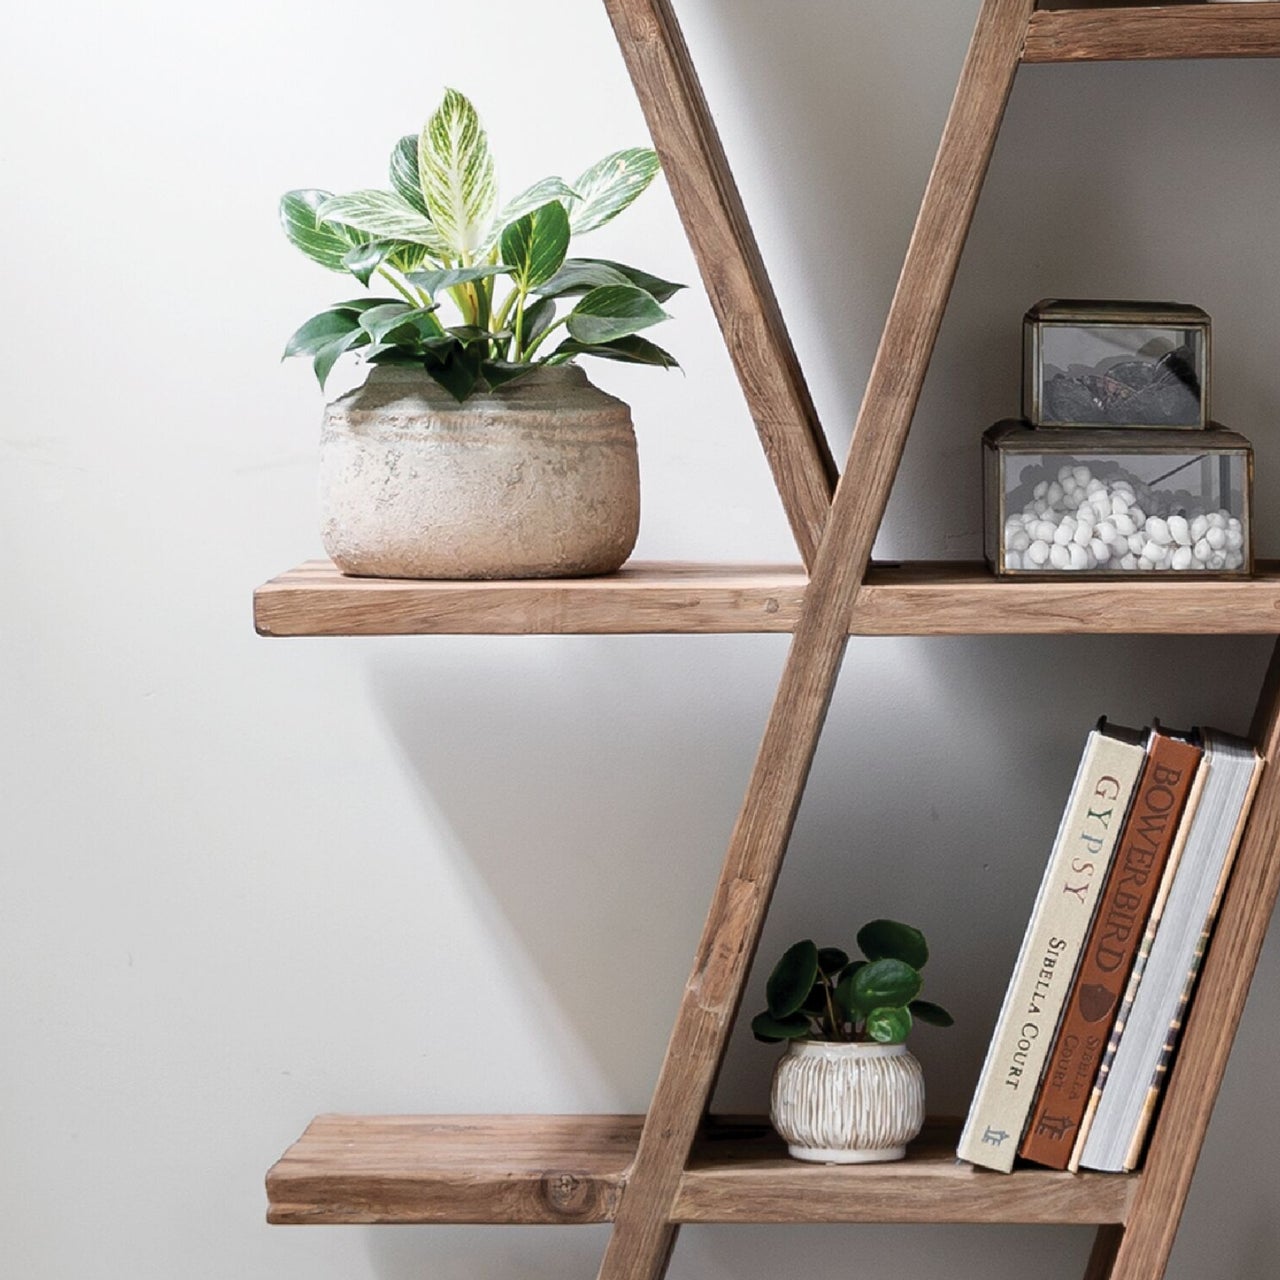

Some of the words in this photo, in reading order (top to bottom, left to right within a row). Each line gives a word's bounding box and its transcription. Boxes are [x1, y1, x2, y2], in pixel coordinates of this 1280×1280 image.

[1062, 775, 1121, 905] GYPSY
[1095, 763, 1183, 973] BOWERBIRD
[1027, 936, 1067, 1015] SIBELLA
[1005, 1022, 1040, 1091] COURT
